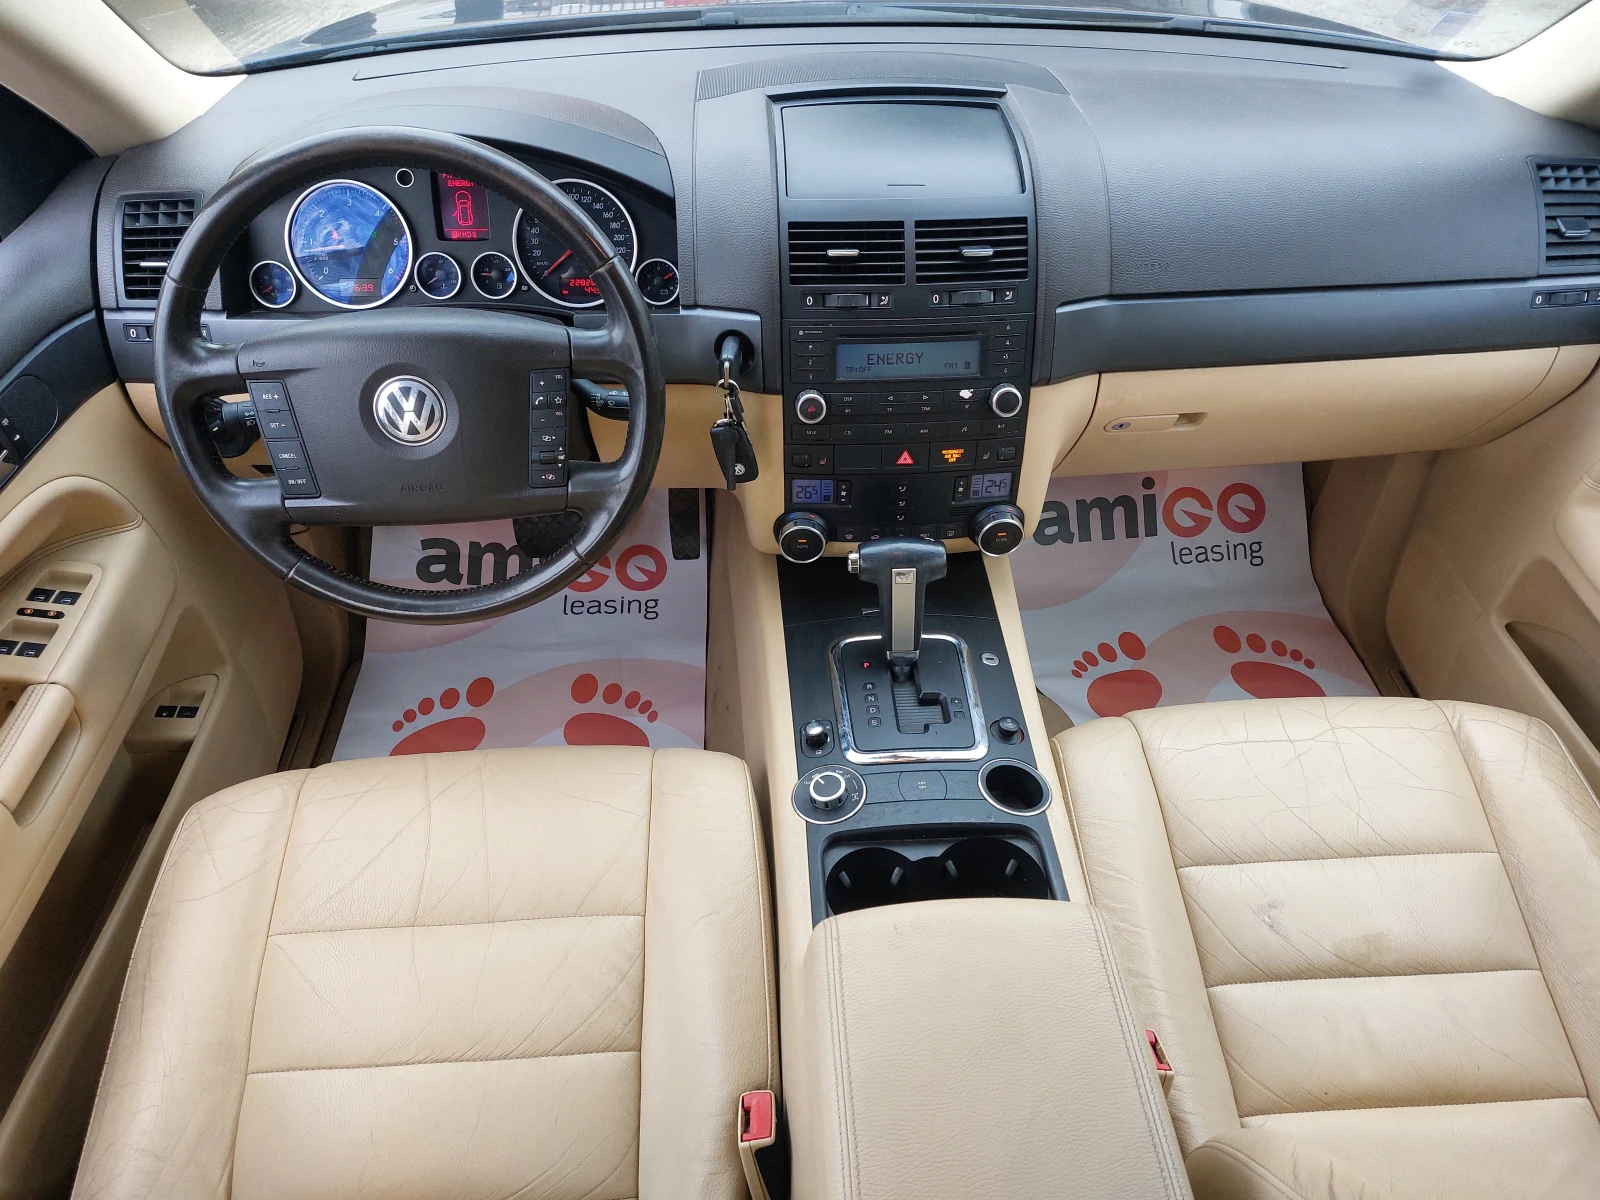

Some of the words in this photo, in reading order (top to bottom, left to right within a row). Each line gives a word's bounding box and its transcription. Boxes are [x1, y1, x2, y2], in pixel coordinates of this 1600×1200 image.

[346, 199, 352, 207] 3
[580, 195, 592, 203] 120
[592, 202, 604, 210] 140
[319, 210, 325, 218] 2
[374, 209, 380, 217] 4
[602, 211, 614, 219] 160
[609, 221, 621, 229] 180
[530, 226, 540, 234] 40
[530, 237, 539, 245] 30
[613, 233, 625, 241] 200
[532, 249, 542, 257] 20
[323, 266, 329, 275] 0
[387, 267, 394, 275] 6
[584, 286, 600, 294] 44
[806, 296, 813, 306] 0
[932, 294, 940, 304] 0
[1535, 295, 1542, 304] 0
[129, 328, 137, 338] 0
[867, 351, 924, 366] ENERGY
[1170, 539, 1265, 567] leasing
[415, 536, 668, 593] amO
[562, 594, 660, 620] leasing
